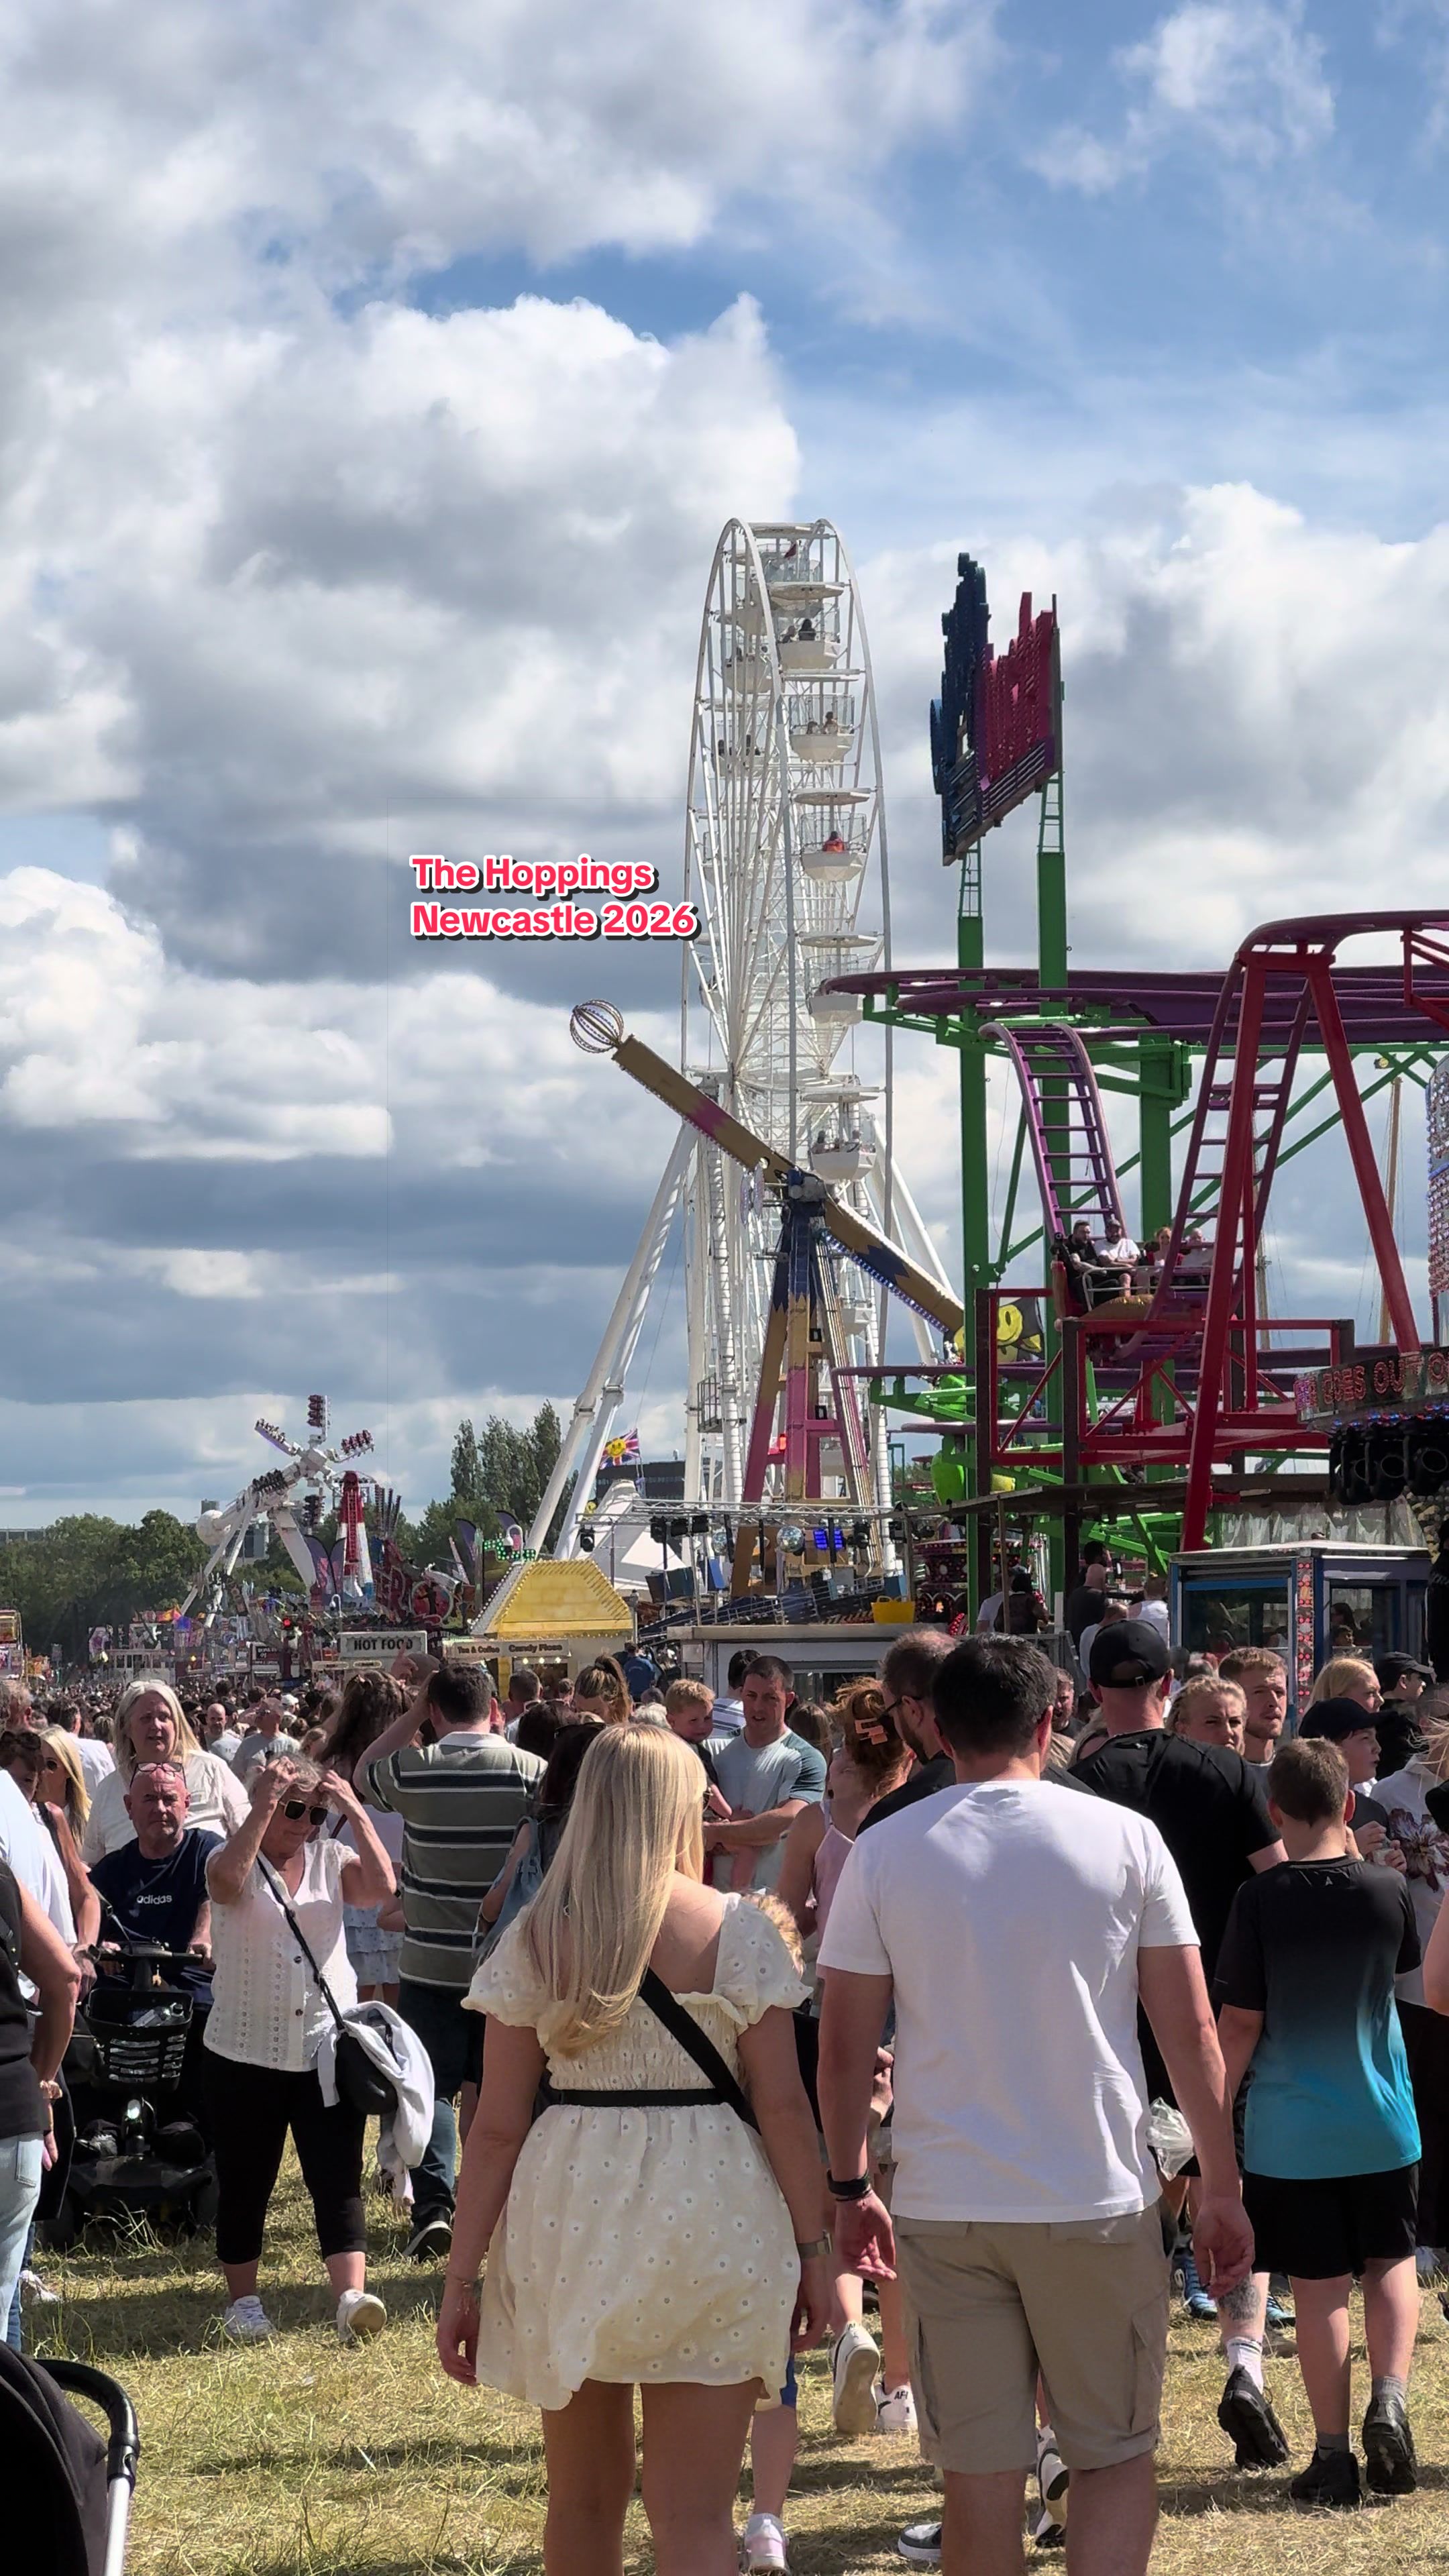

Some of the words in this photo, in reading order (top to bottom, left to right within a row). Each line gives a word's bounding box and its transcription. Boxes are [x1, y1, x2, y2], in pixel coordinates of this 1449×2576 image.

[354, 1639, 377, 1651] HOT
[382, 1638, 413, 1650] FOOD
[508, 1644, 537, 1653] Candy
[539, 1644, 563, 1652] Floss
[458, 1646, 469, 1654] Tea
[478, 1645, 500, 1654] Coffee
[137, 1894, 172, 1904] adidas
